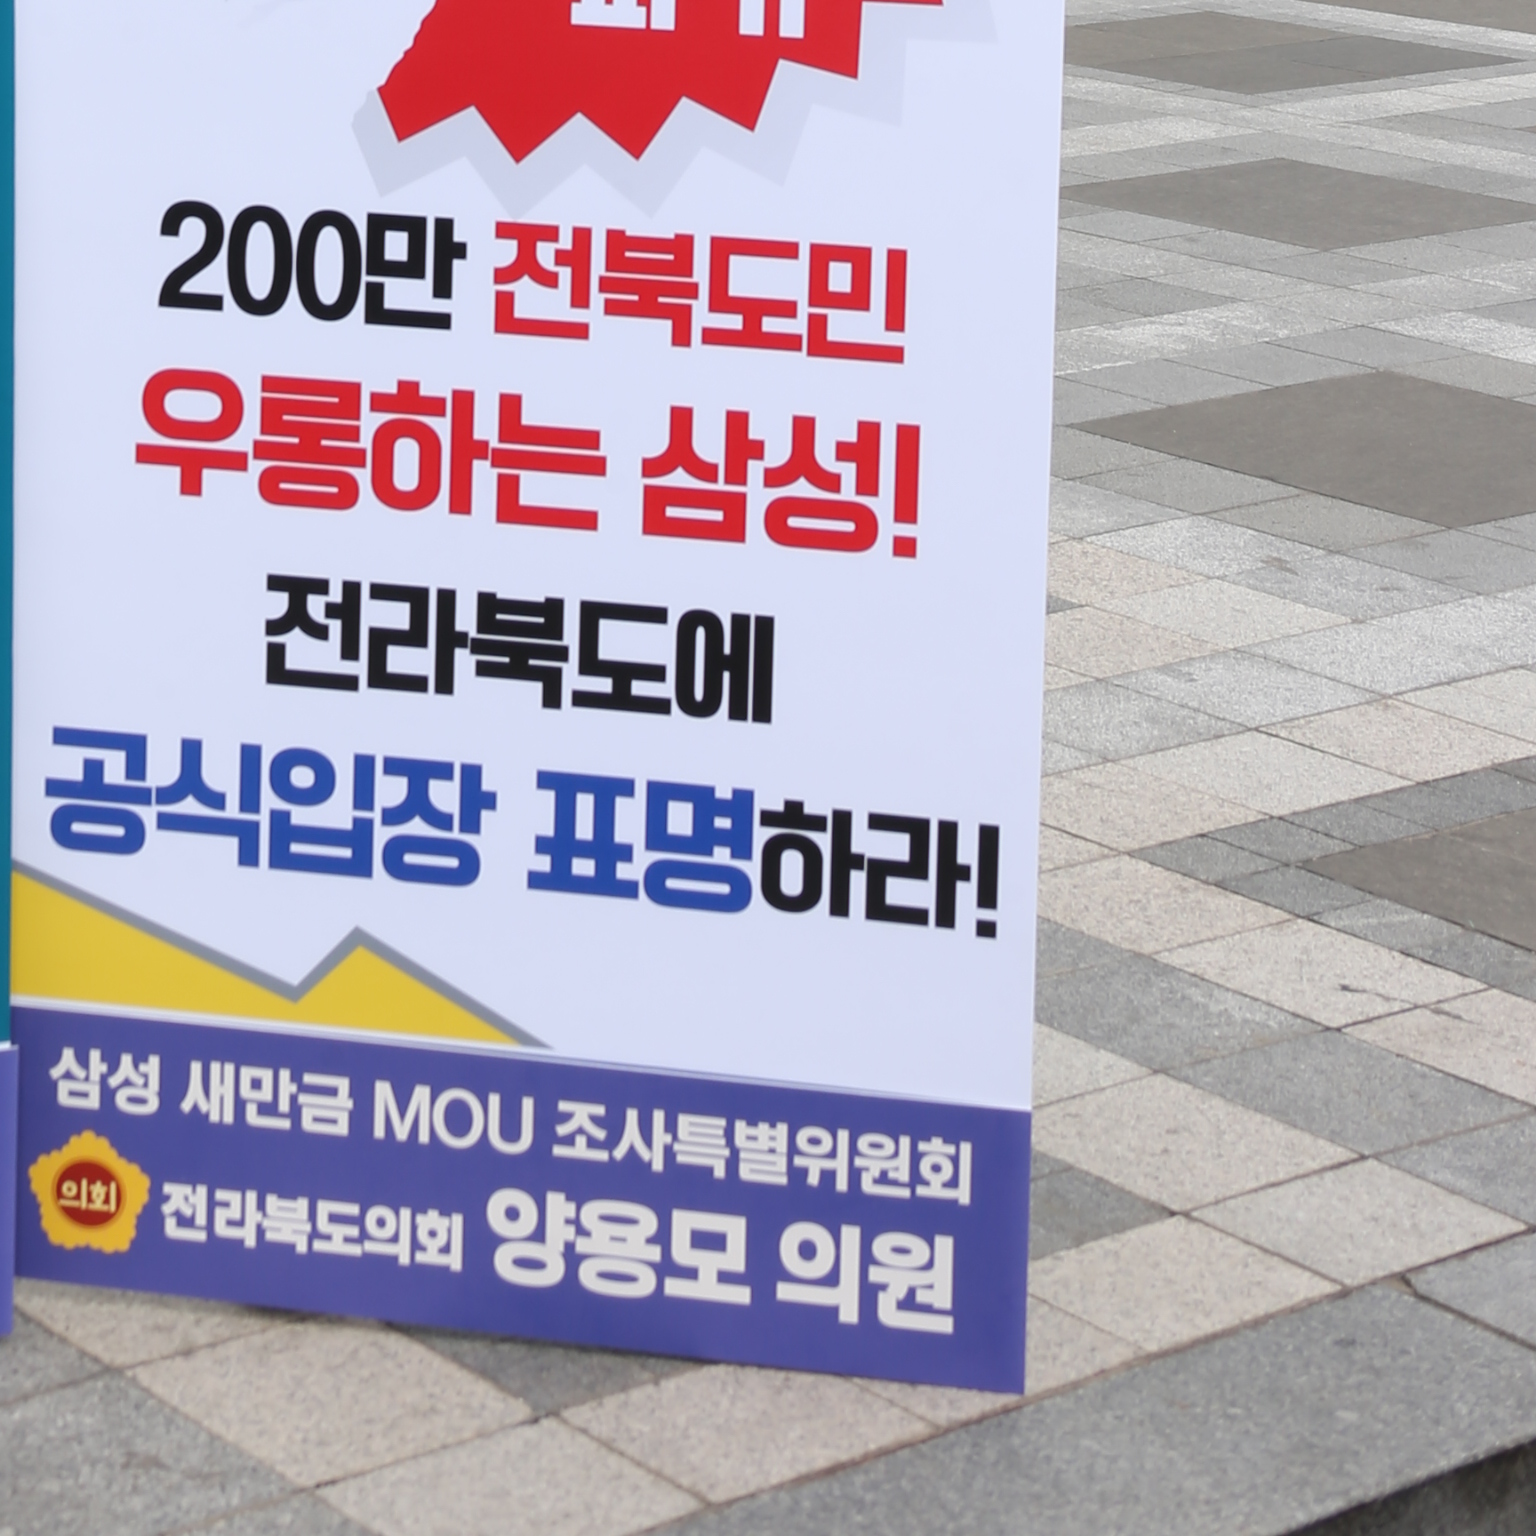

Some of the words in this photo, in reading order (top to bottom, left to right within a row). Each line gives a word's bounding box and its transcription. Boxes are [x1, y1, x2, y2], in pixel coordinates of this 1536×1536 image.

[157, 200, 468, 331] 200만
[491, 220, 909, 365] 전북도민
[134, 366, 607, 532] 우롱하는
[640, 405, 922, 560] 삼성!
[263, 572, 776, 725] 전라북도에
[43, 725, 498, 889] 공식입장
[525, 767, 1001, 939] 표명하라!
[49, 1046, 161, 1116] 삼성
[180, 1056, 354, 1137] 새만금
[372, 1079, 534, 1156] MOU
[551, 1098, 974, 1207] 조사특별위원회
[58, 1177, 117, 1213] 의회
[159, 1181, 465, 1272] 전라북도의회
[485, 1186, 752, 1307] 양용모
[775, 1220, 955, 1335] 의원
